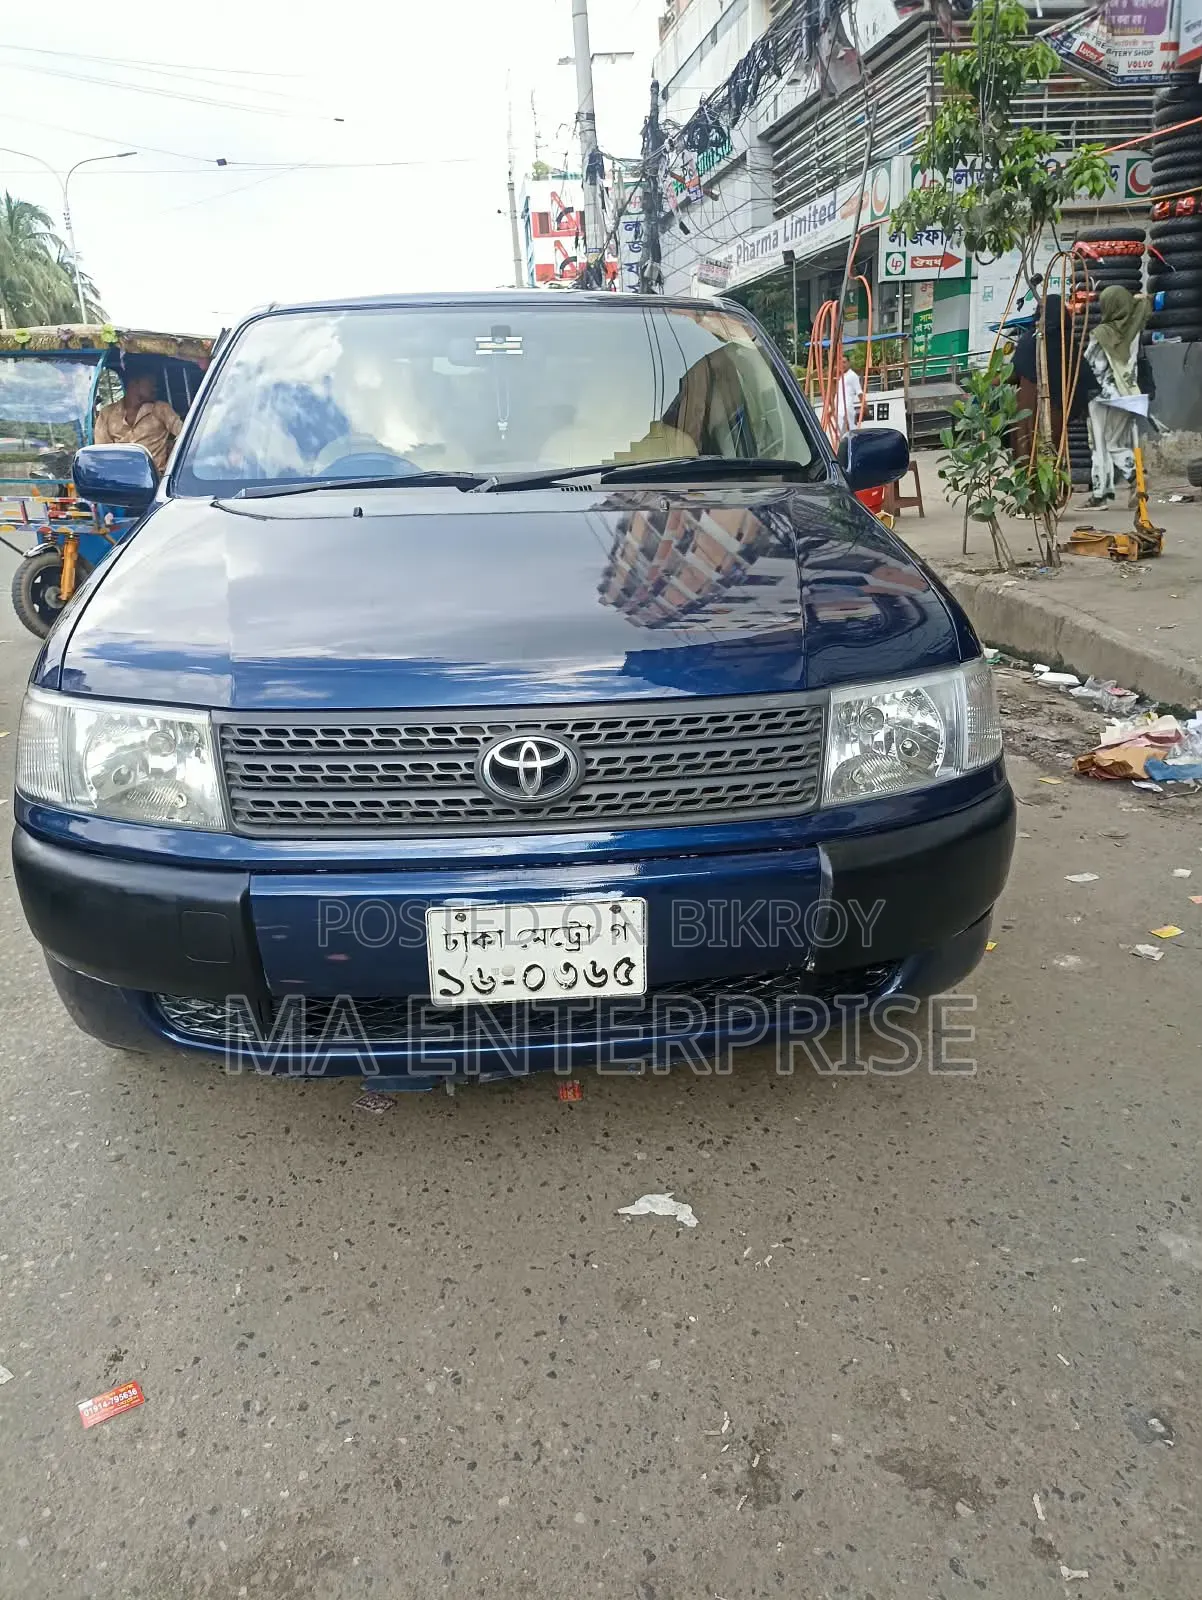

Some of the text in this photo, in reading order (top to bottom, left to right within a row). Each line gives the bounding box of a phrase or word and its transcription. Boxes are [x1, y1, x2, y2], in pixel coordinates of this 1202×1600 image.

[1133, 49, 1154, 57] SHOP
[1127, 60, 1154, 69] VOLVO
[736, 229, 779, 266] Pharma
[783, 194, 837, 244] Limited
[442, 921, 631, 953] ঢাকা মেট্রো গ
